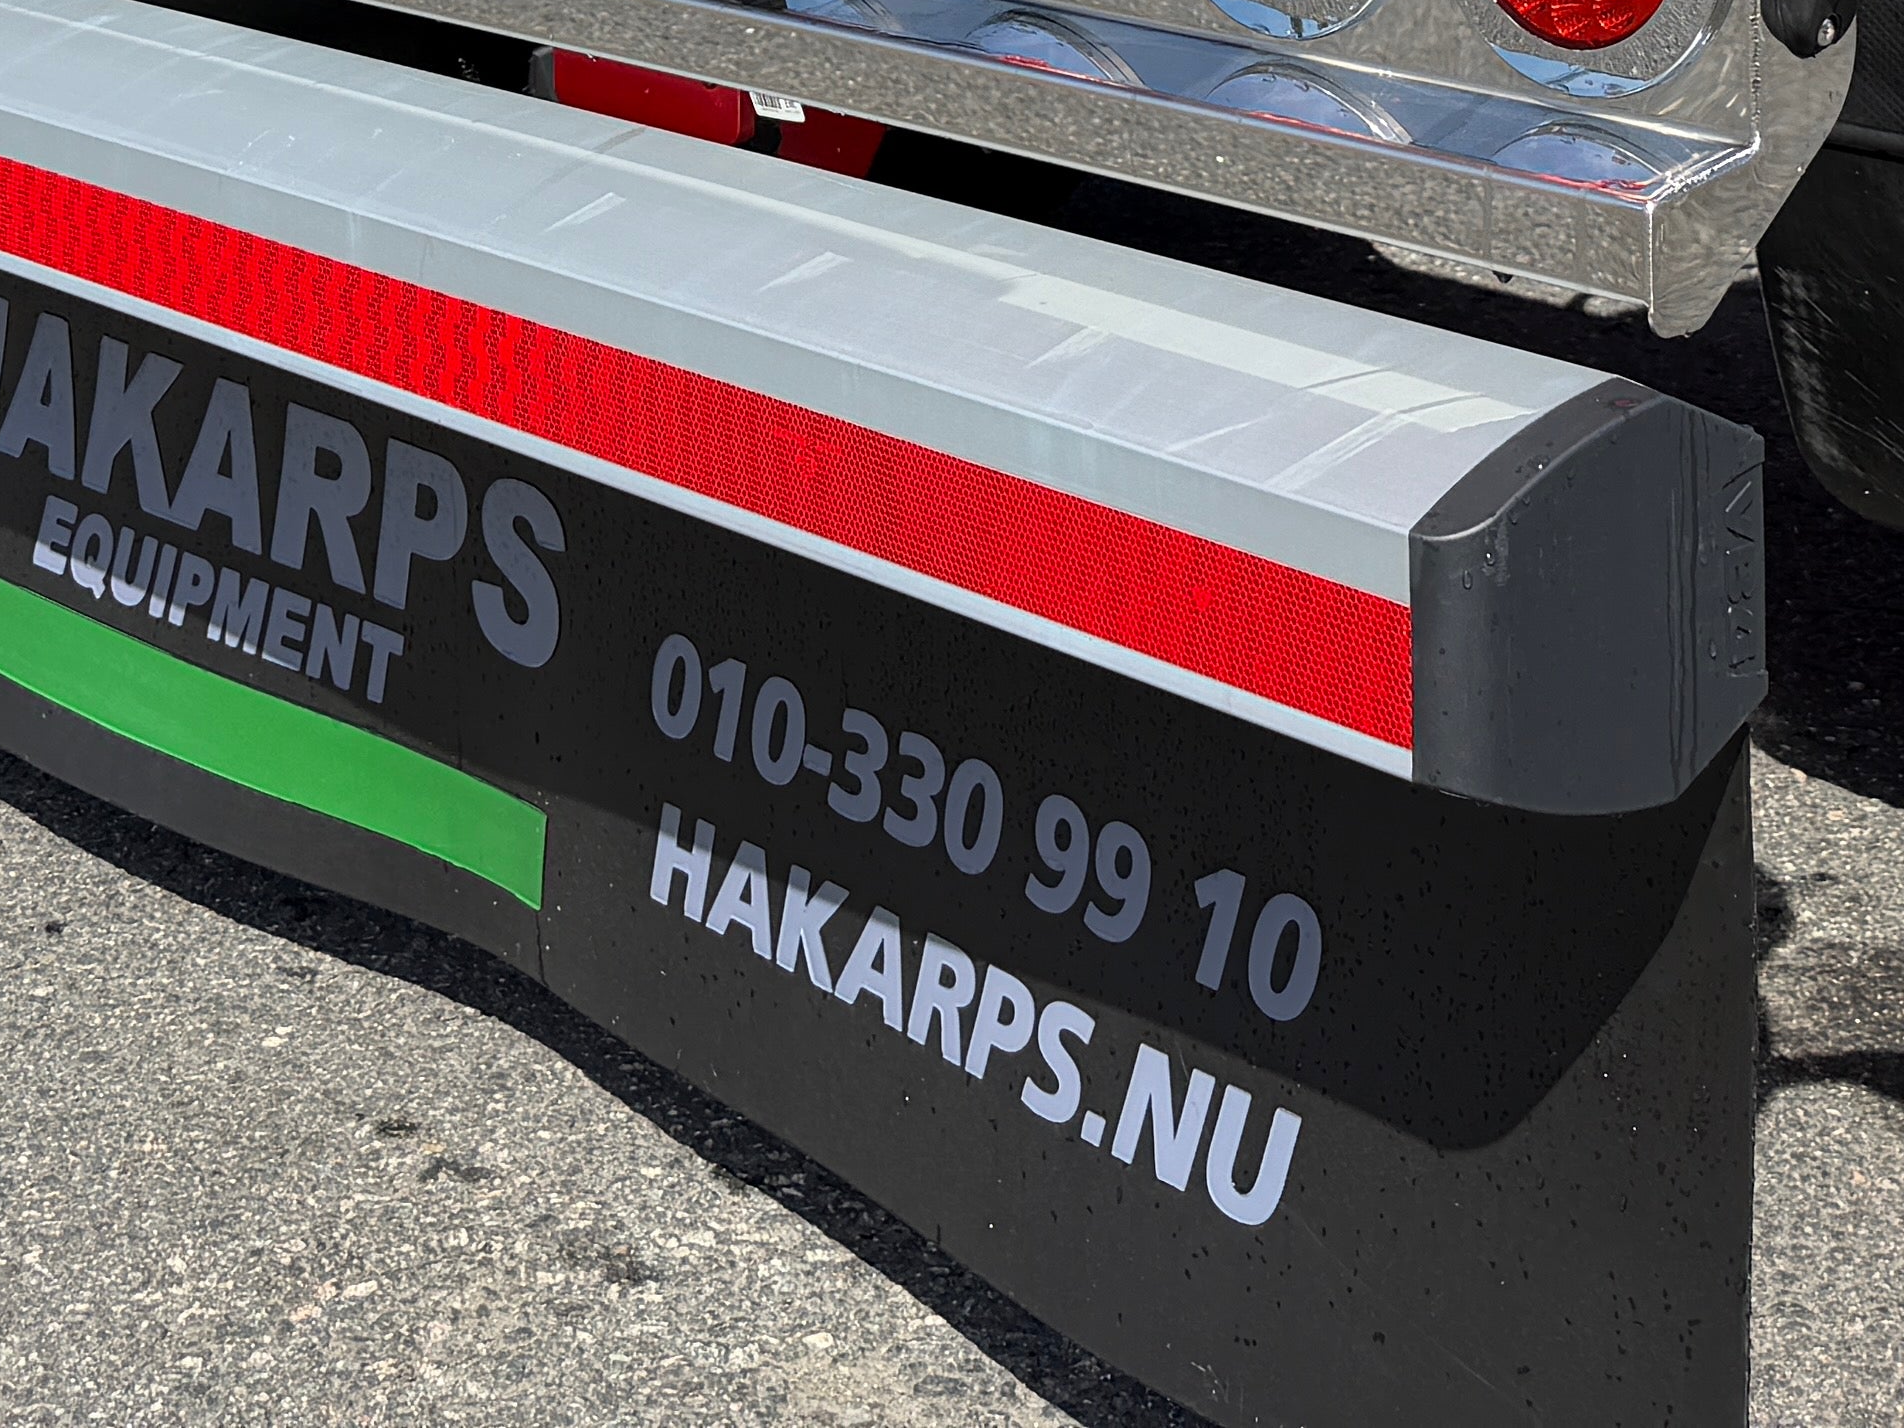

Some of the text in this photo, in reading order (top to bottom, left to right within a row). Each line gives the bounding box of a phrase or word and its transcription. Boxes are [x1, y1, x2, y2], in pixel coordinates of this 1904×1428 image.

[32, 495, 405, 705] EQUIPMENT
[648, 801, 1302, 1227] HAKARPS.NU
[650, 632, 1323, 1022] 010-330 99 10
